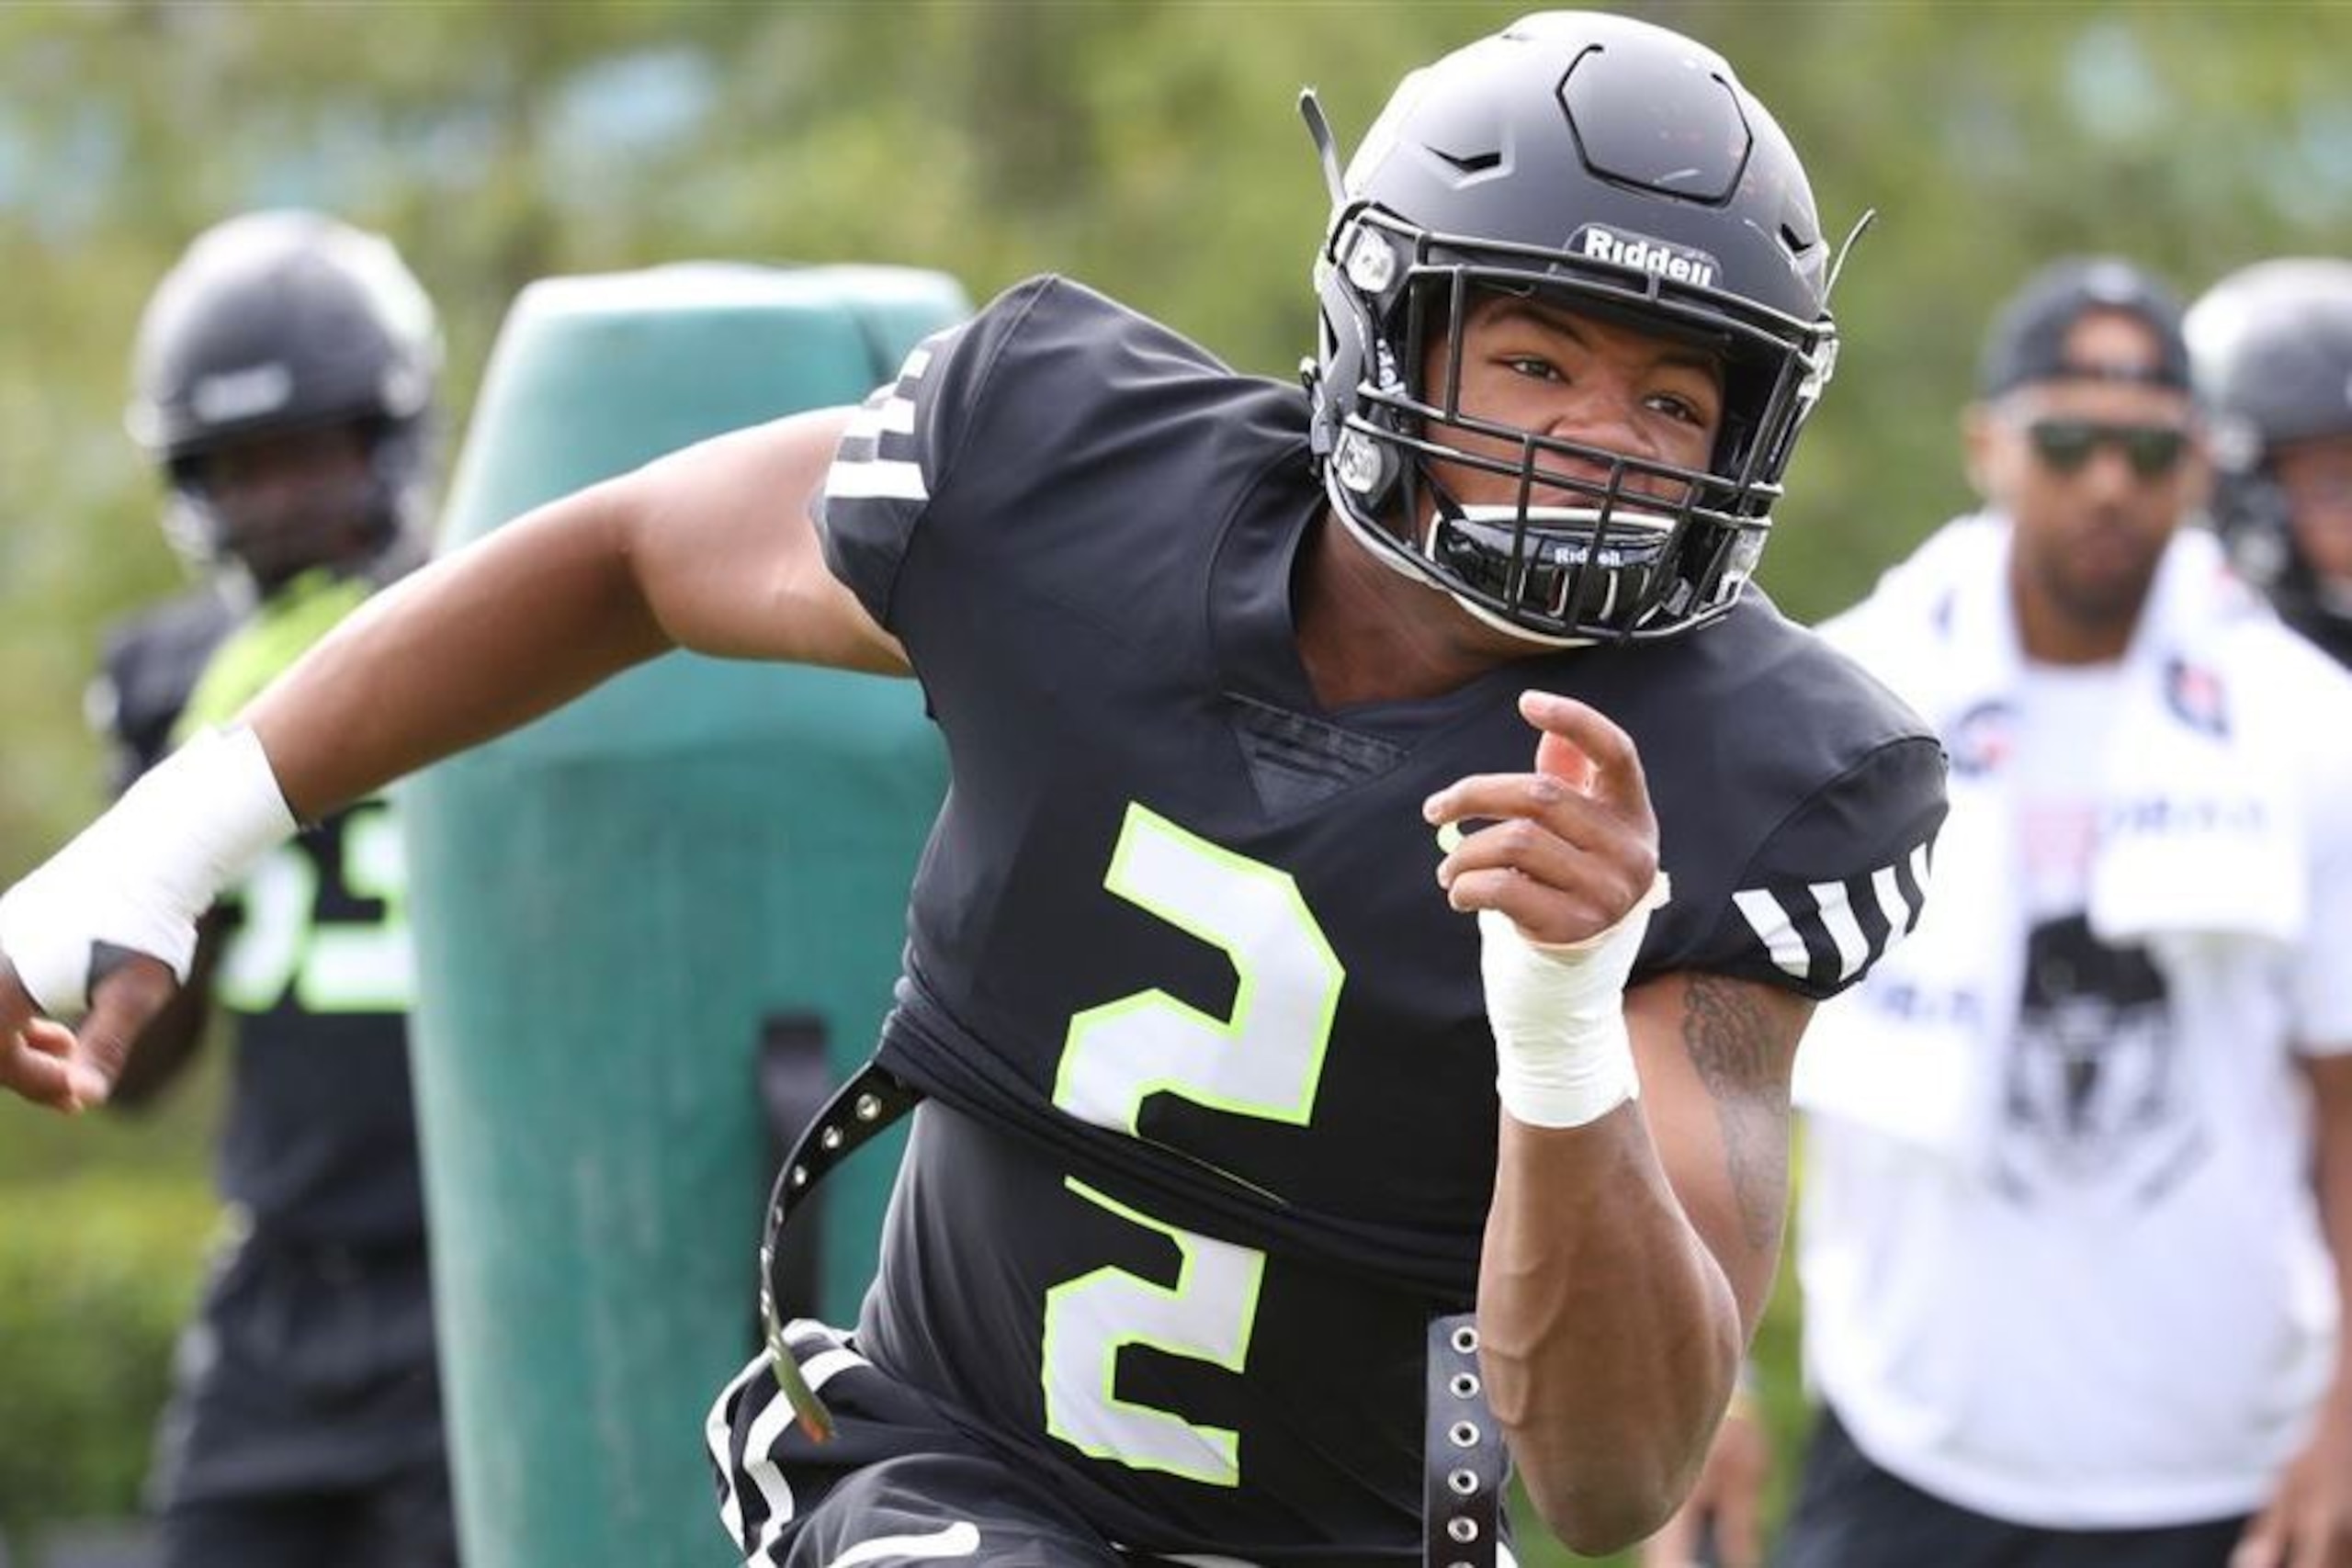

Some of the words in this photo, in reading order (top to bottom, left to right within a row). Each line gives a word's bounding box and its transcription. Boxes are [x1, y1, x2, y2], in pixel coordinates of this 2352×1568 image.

[1584, 227, 1713, 288] Riddell
[1555, 546, 1621, 568] Ridell
[1051, 799, 1346, 1140] 2
